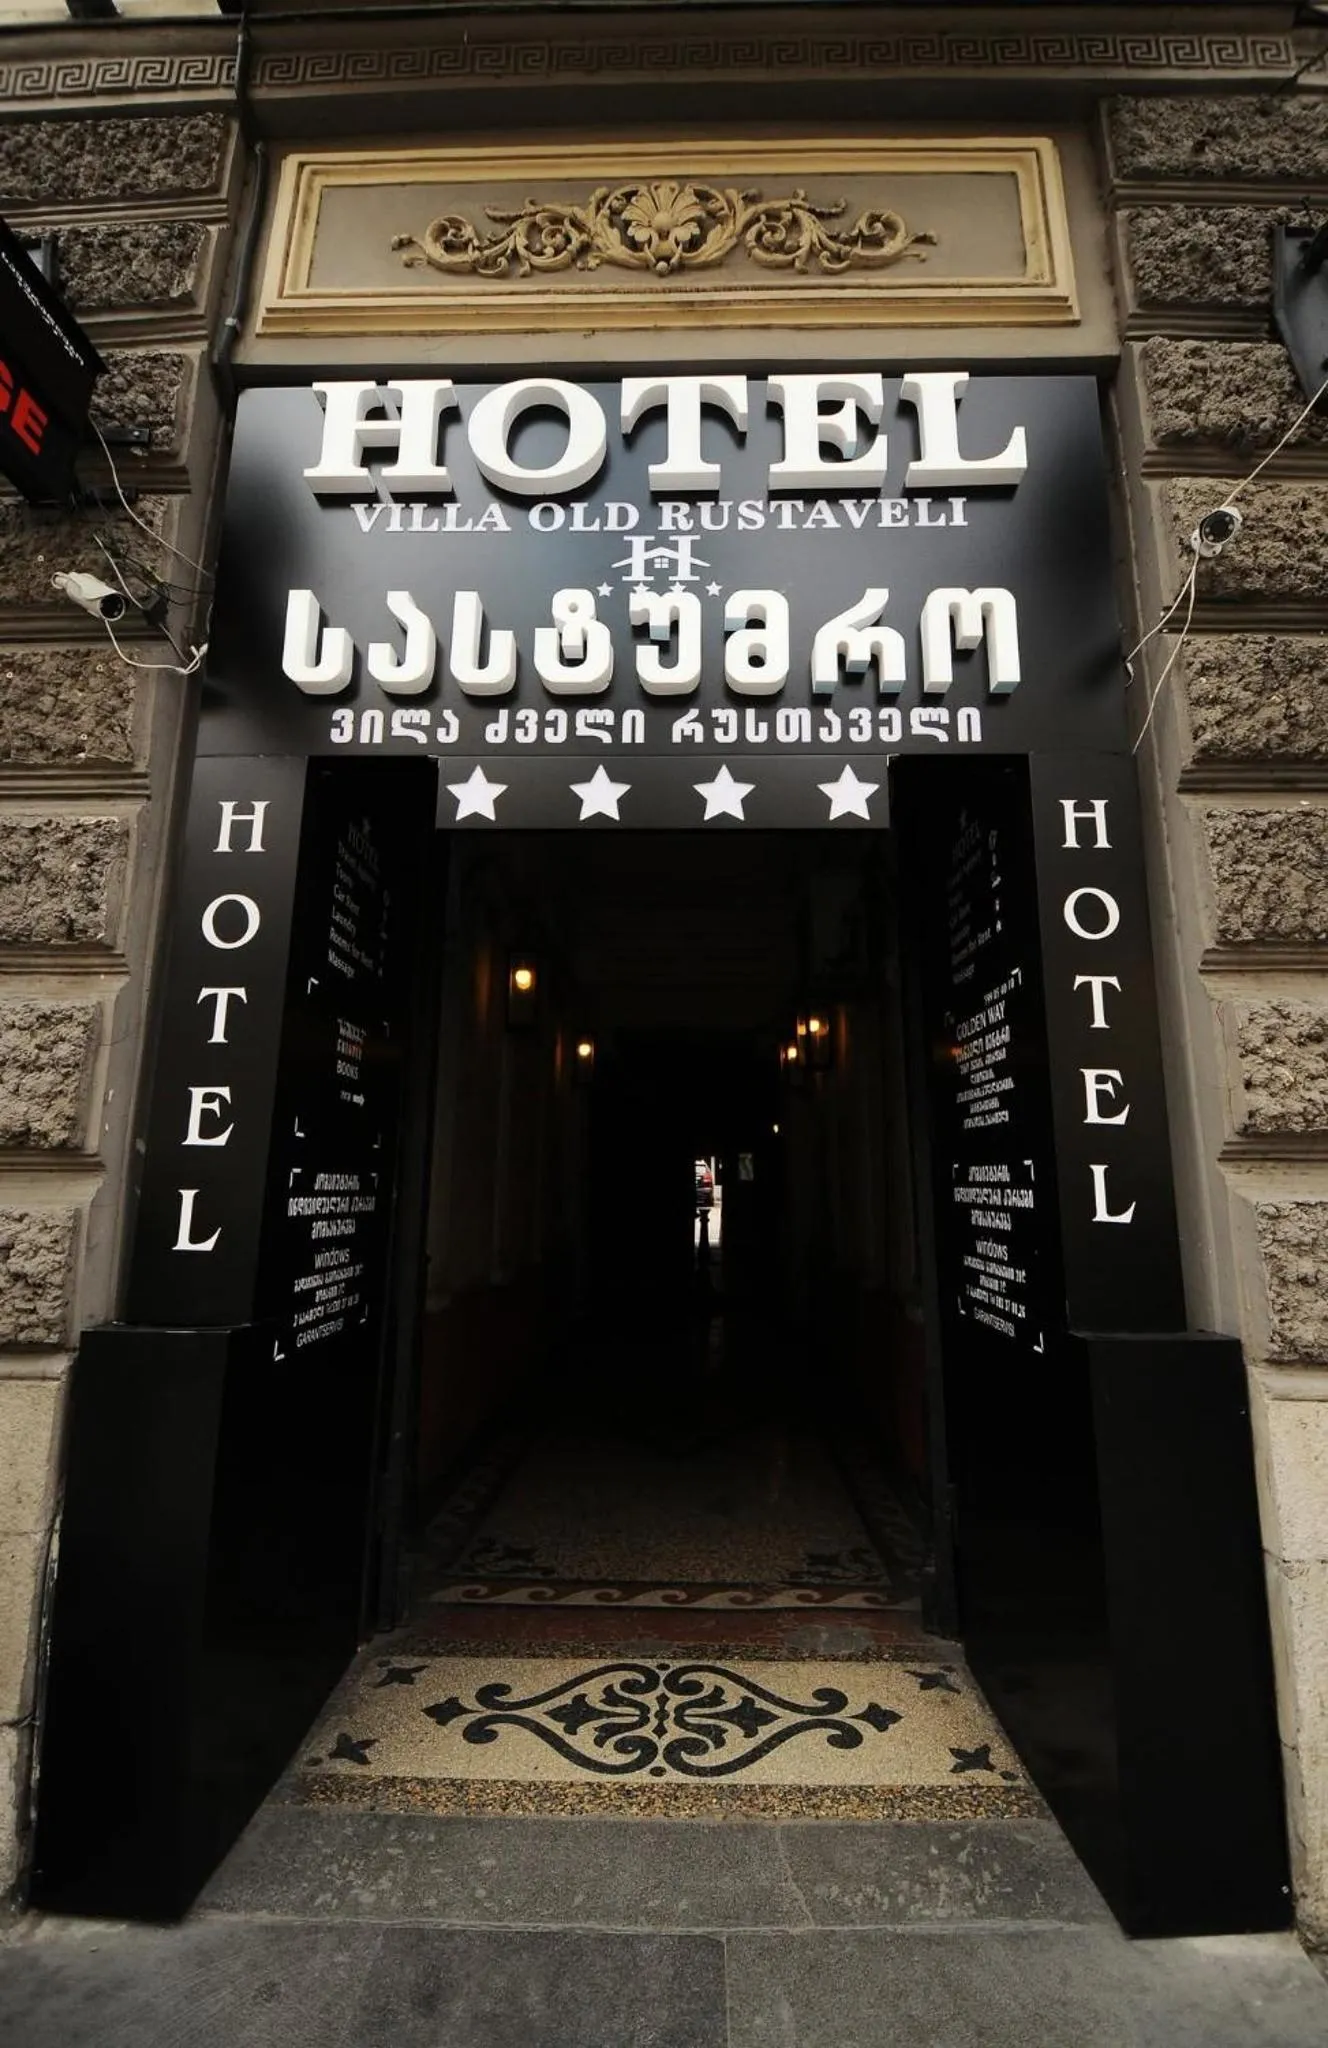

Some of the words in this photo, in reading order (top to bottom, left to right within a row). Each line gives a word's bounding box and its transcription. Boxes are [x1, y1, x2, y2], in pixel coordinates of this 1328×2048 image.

[304, 372, 1028, 495] HOTEL
[352, 502, 512, 534] VILLA
[528, 501, 639, 532] OLD
[657, 497, 969, 532] RUSTAVELI
[282, 587, 1021, 696] სასტუმრო
[330, 708, 460, 744] ვილა
[485, 708, 645, 744] ძველი
[672, 706, 982, 744] რუსთაველი
[172, 800, 270, 1251] HOTEL
[956, 1010, 987, 1041] GOLDEN
[986, 1001, 1006, 1028] WAY
[1059, 799, 1136, 1223] HOTEL
